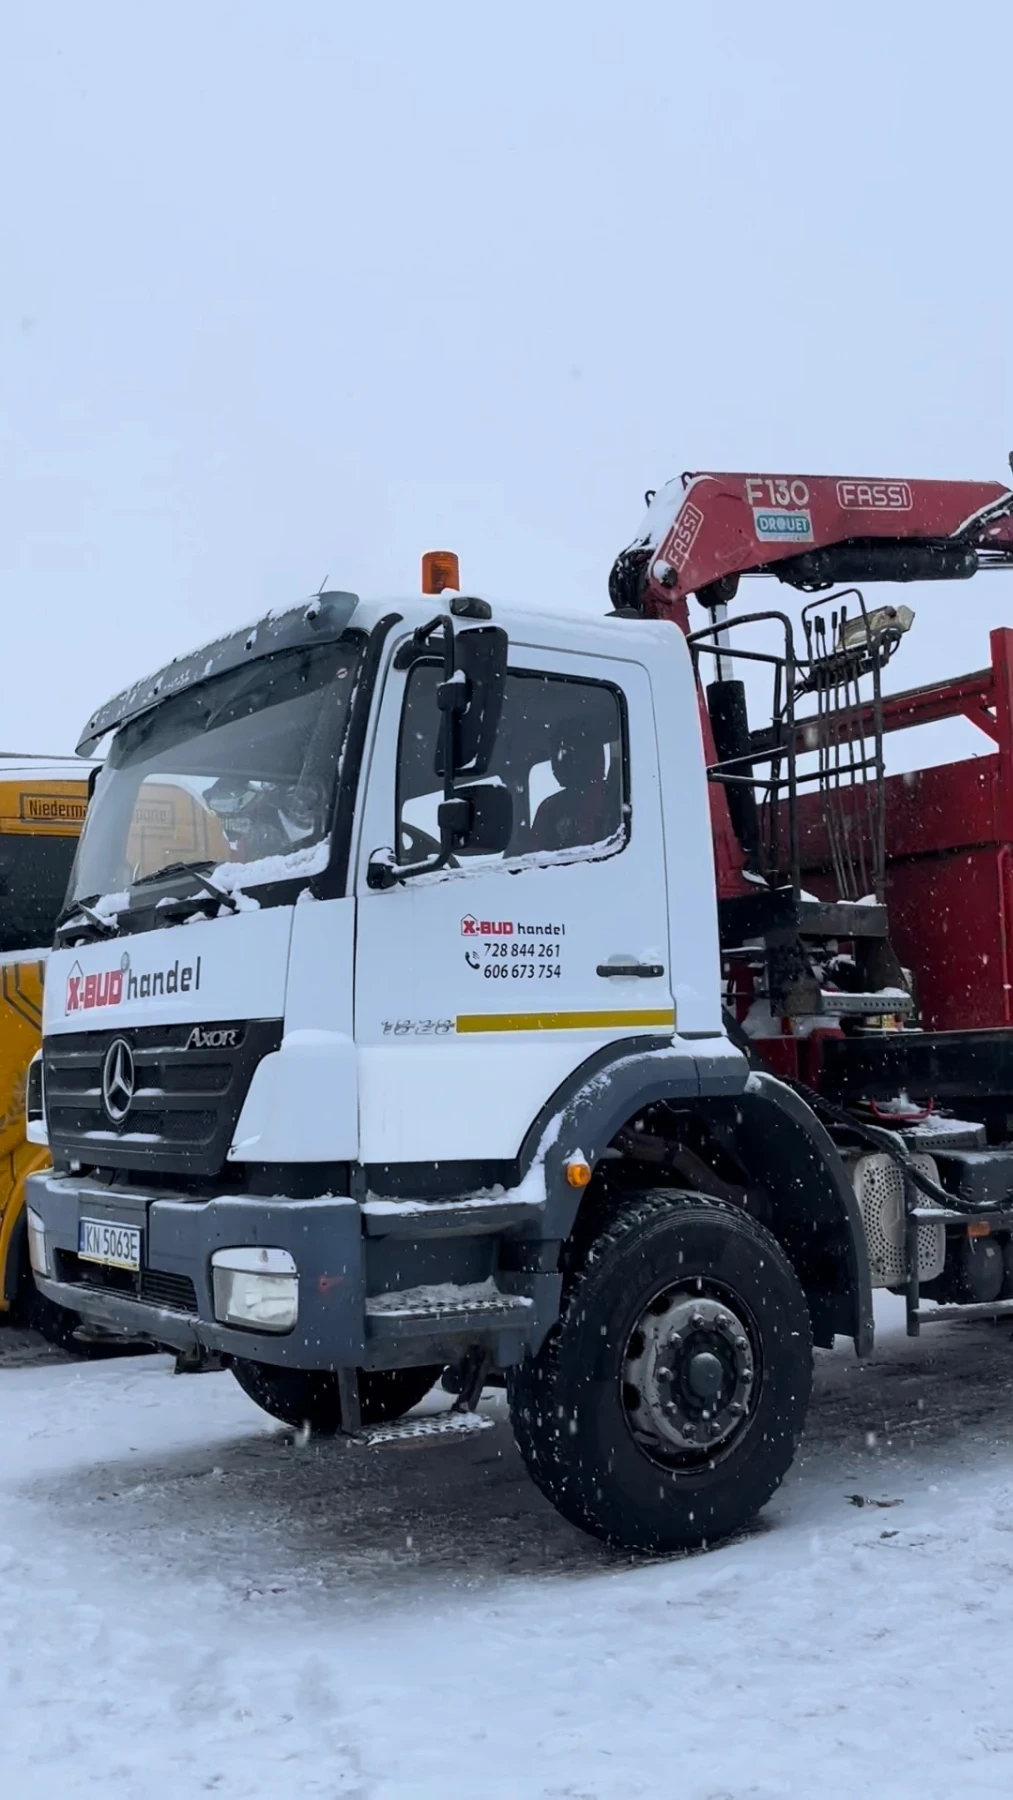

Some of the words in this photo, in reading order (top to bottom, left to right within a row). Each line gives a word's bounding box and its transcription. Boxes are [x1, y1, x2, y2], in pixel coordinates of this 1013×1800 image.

[745, 478, 810, 506] F130
[842, 485, 908, 507] FASSI
[759, 517, 808, 532] DROUET
[668, 508, 700, 566] FASSI
[463, 920, 513, 936] X-BUD
[517, 922, 565, 936] handel
[484, 943, 508, 957] 728
[511, 943, 535, 957] 844
[538, 943, 561, 958] 261
[484, 964, 508, 979] 606
[511, 964, 535, 979] 673
[538, 964, 561, 979] 754
[66, 969, 124, 1012] X-BUD
[127, 956, 201, 1000] handel
[86, 1225, 100, 1254] KN
[103, 1228, 138, 1262] 5063E
